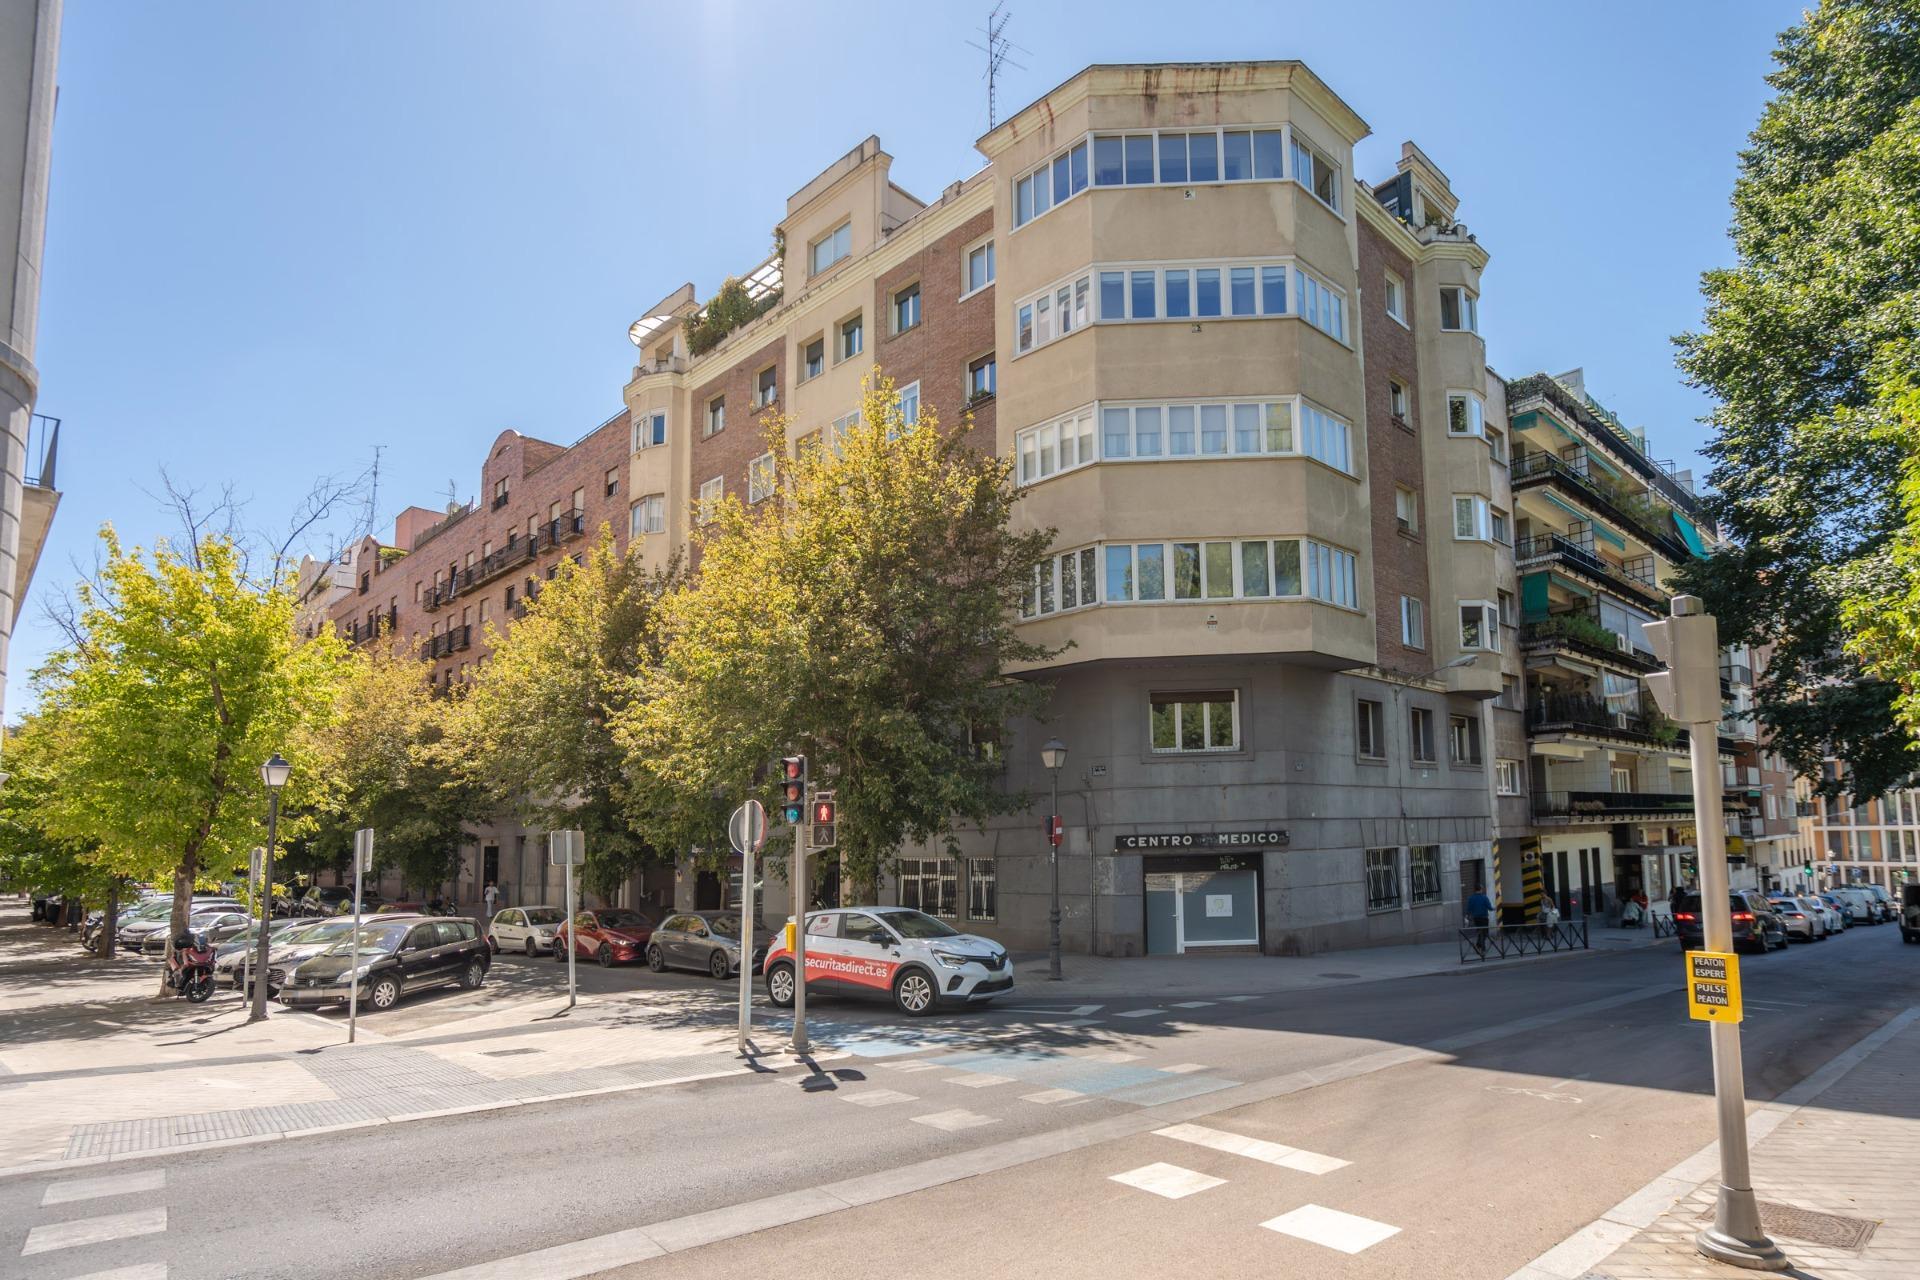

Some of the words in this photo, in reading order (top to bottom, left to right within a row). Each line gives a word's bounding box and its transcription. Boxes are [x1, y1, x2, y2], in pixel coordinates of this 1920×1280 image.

[1127, 835, 1193, 847] CENTRO
[1218, 833, 1279, 845] MEDICO
[1695, 958, 1724, 966] PEATON
[805, 958, 887, 977] securitasdirect.es
[1696, 969, 1725, 978] ESPERE
[1697, 984, 1726, 993] PULSE
[1697, 995, 1727, 1004] PEATON
